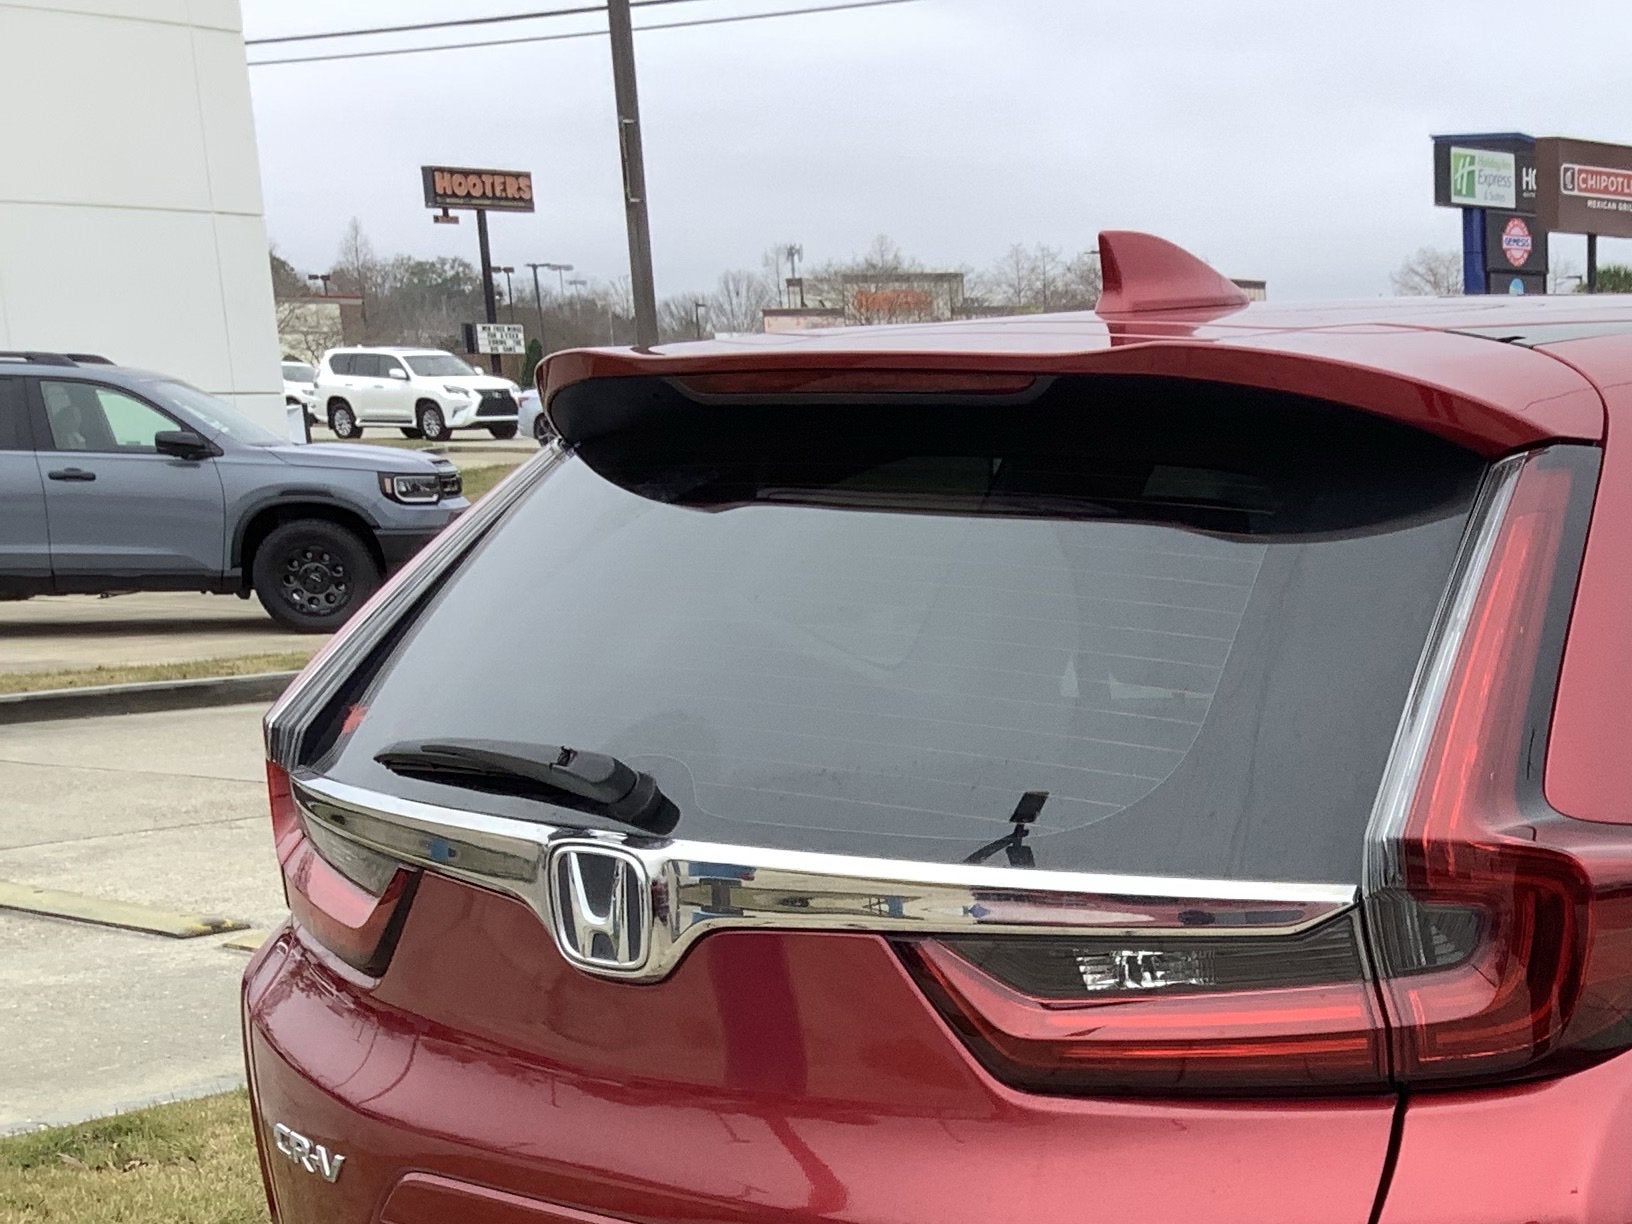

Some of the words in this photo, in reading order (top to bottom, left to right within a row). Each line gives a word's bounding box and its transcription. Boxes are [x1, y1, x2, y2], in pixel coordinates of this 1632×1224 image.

[434, 171, 531, 199] HOOTERS
[1477, 168, 1512, 188] Express
[1587, 199, 1617, 210] MEXICAN
[273, 1122, 347, 1184] CR-V
